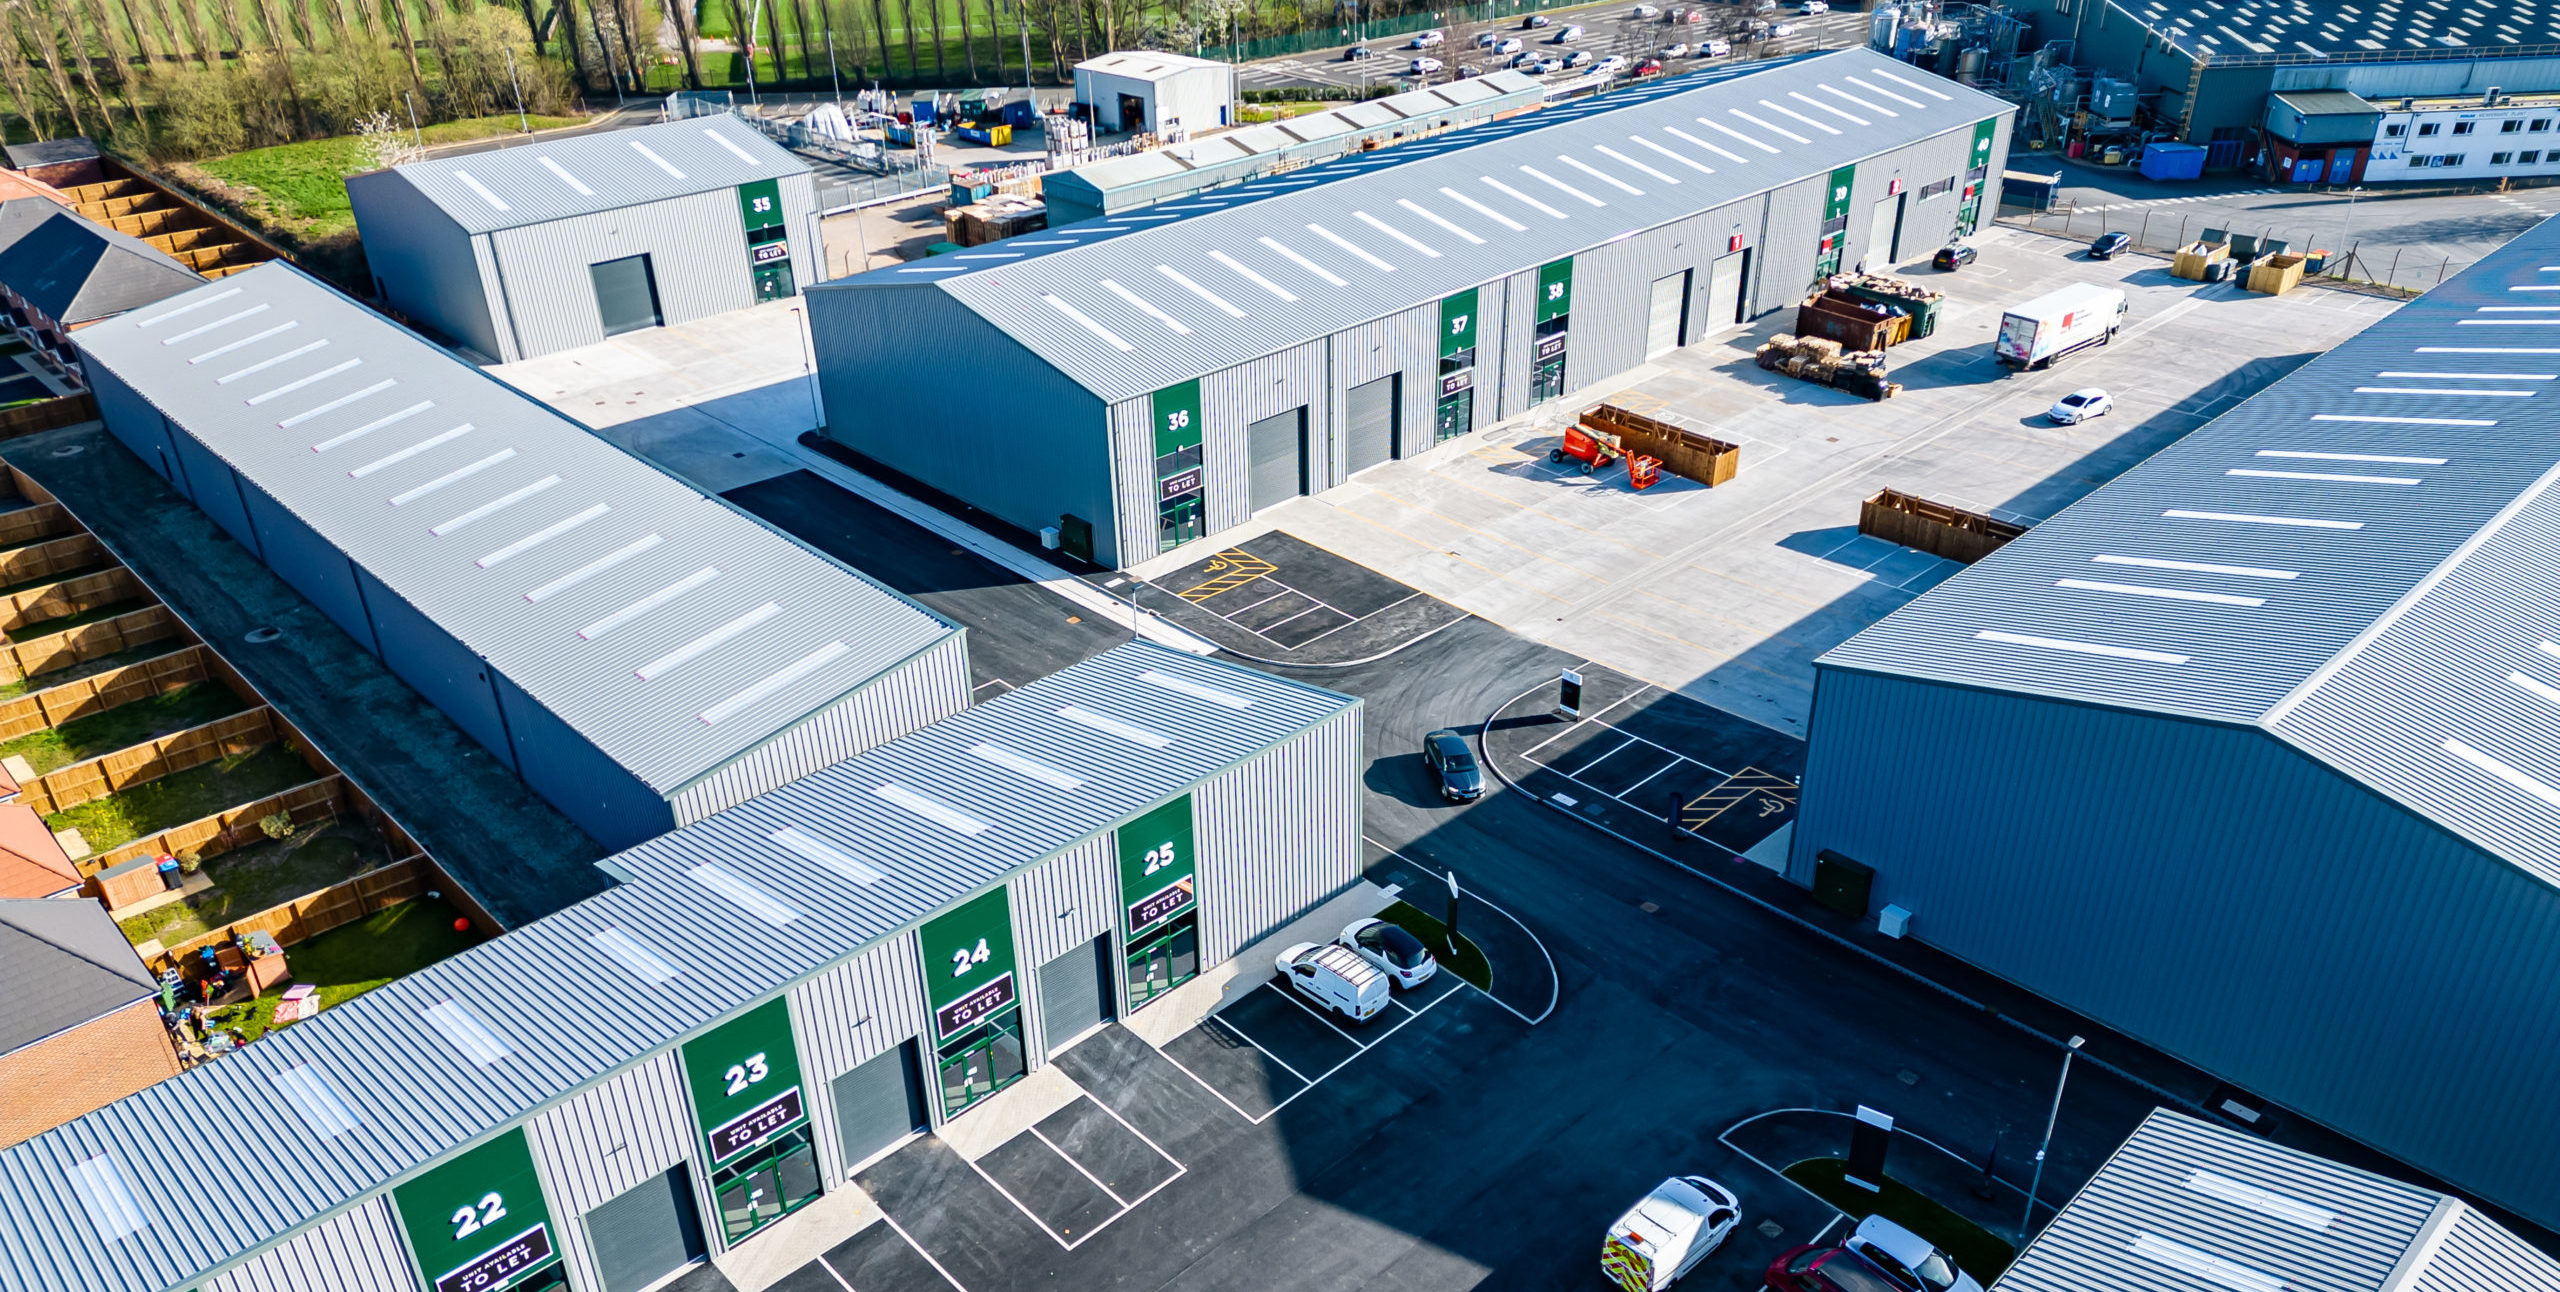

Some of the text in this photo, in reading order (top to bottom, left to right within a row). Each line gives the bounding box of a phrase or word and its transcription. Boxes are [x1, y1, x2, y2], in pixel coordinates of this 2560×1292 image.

[1977, 137, 1990, 151] 40
[752, 196, 771, 212] 35
[1834, 185, 1848, 202] 39
[1734, 236, 1740, 249] 1
[758, 251, 769, 260] TO
[769, 249, 782, 258] LET
[1548, 282, 1564, 301] 38
[1451, 315, 1468, 335] 37
[1542, 347, 1551, 356] TO
[1551, 342, 1562, 352] LET
[1446, 382, 1456, 391] TO
[1456, 377, 1468, 388] LET
[1167, 409, 1189, 431] 36
[1168, 484, 1180, 493] TO
[1181, 477, 1196, 489] LET
[1144, 841, 1175, 877] 25
[1141, 892, 1184, 921] TO LET
[1155, 888, 1181, 905] AVAILABLE
[952, 937, 991, 978] 24
[952, 991, 1002, 1025] TO LET
[954, 986, 999, 1014] UNIT AVAILABLE
[724, 1051, 769, 1097] 23
[727, 1108, 788, 1147] TO LET
[729, 1104, 783, 1136] UNIT AVAILABLE
[450, 1191, 507, 1240] 22
[460, 1247, 532, 1292] TO LET
[462, 1243, 526, 1281] UNIT AVAILABLE
